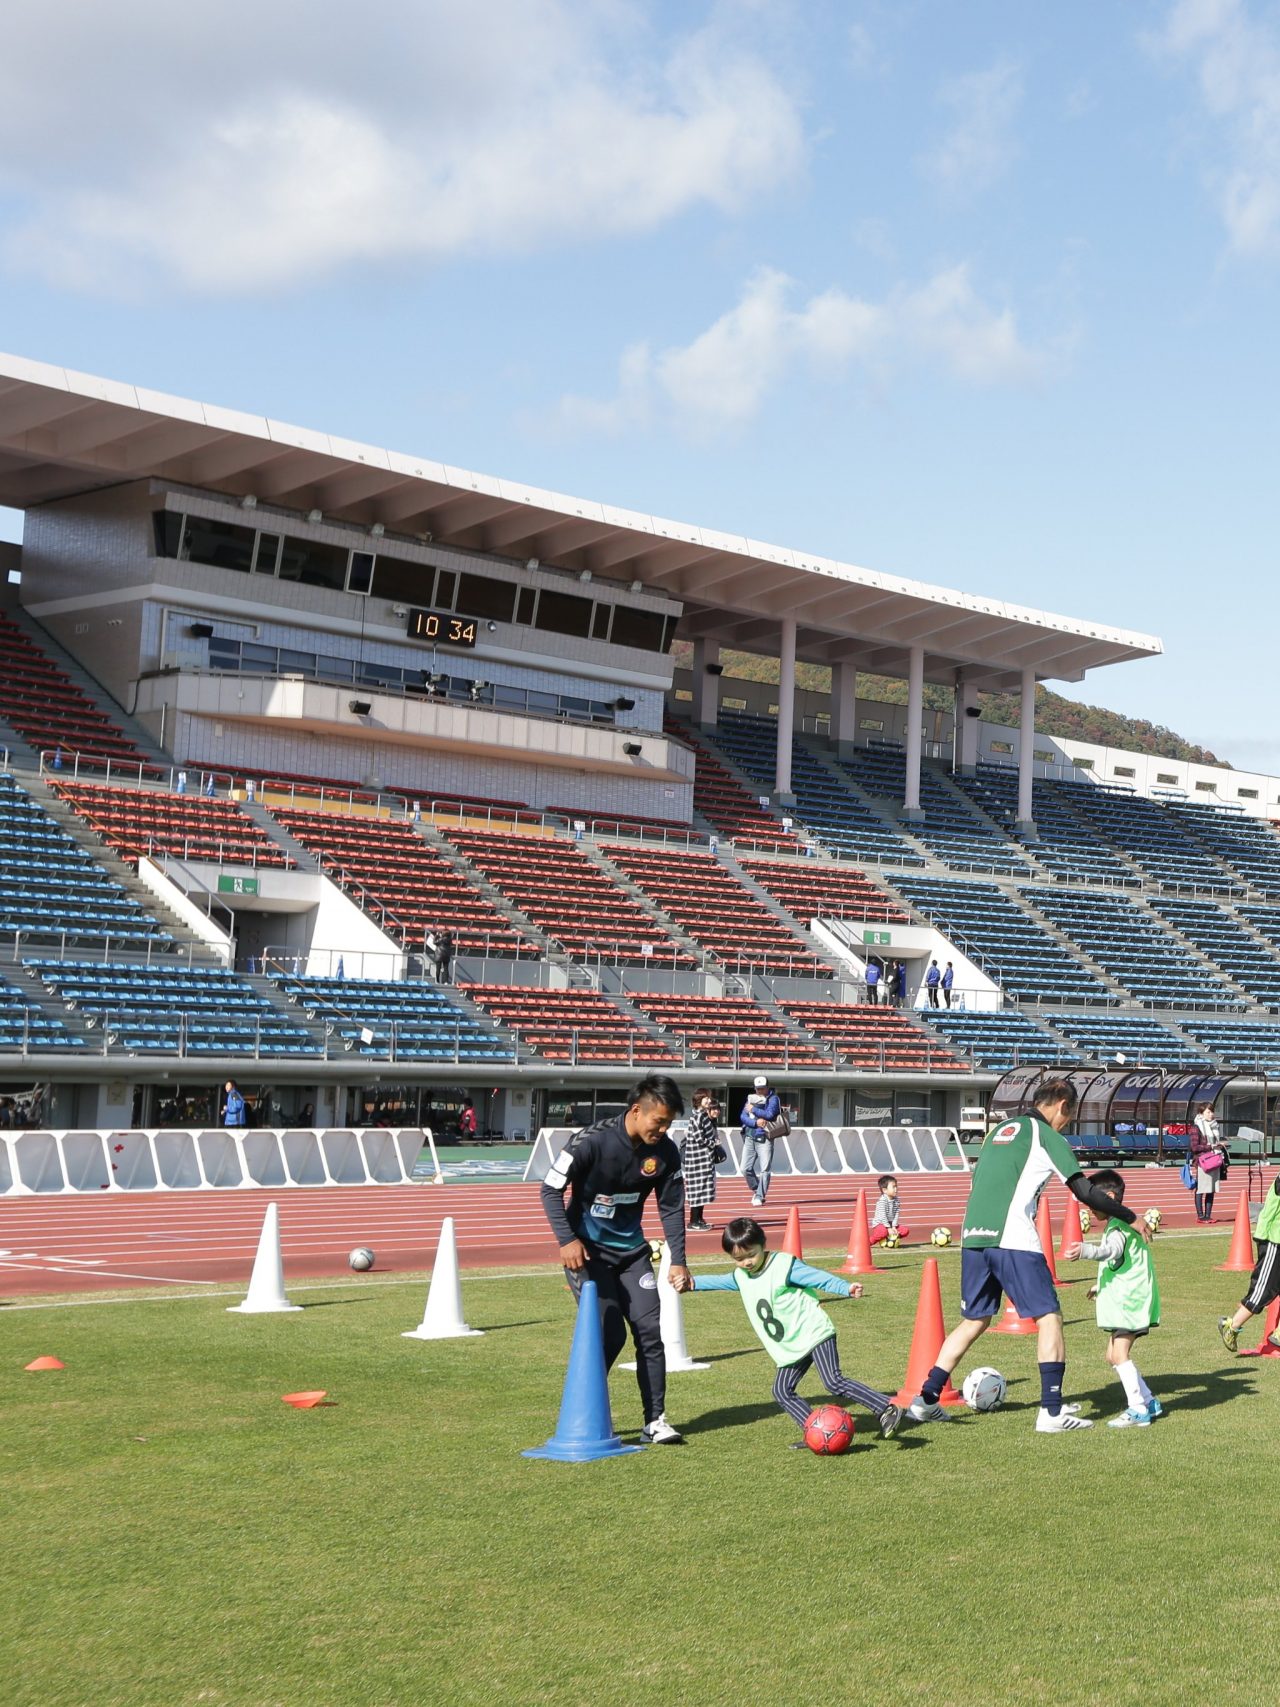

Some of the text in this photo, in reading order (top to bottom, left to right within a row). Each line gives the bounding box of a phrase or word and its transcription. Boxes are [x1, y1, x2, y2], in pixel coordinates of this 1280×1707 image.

[416, 613, 474, 643] 10 34
[756, 1298, 785, 1343] 8
